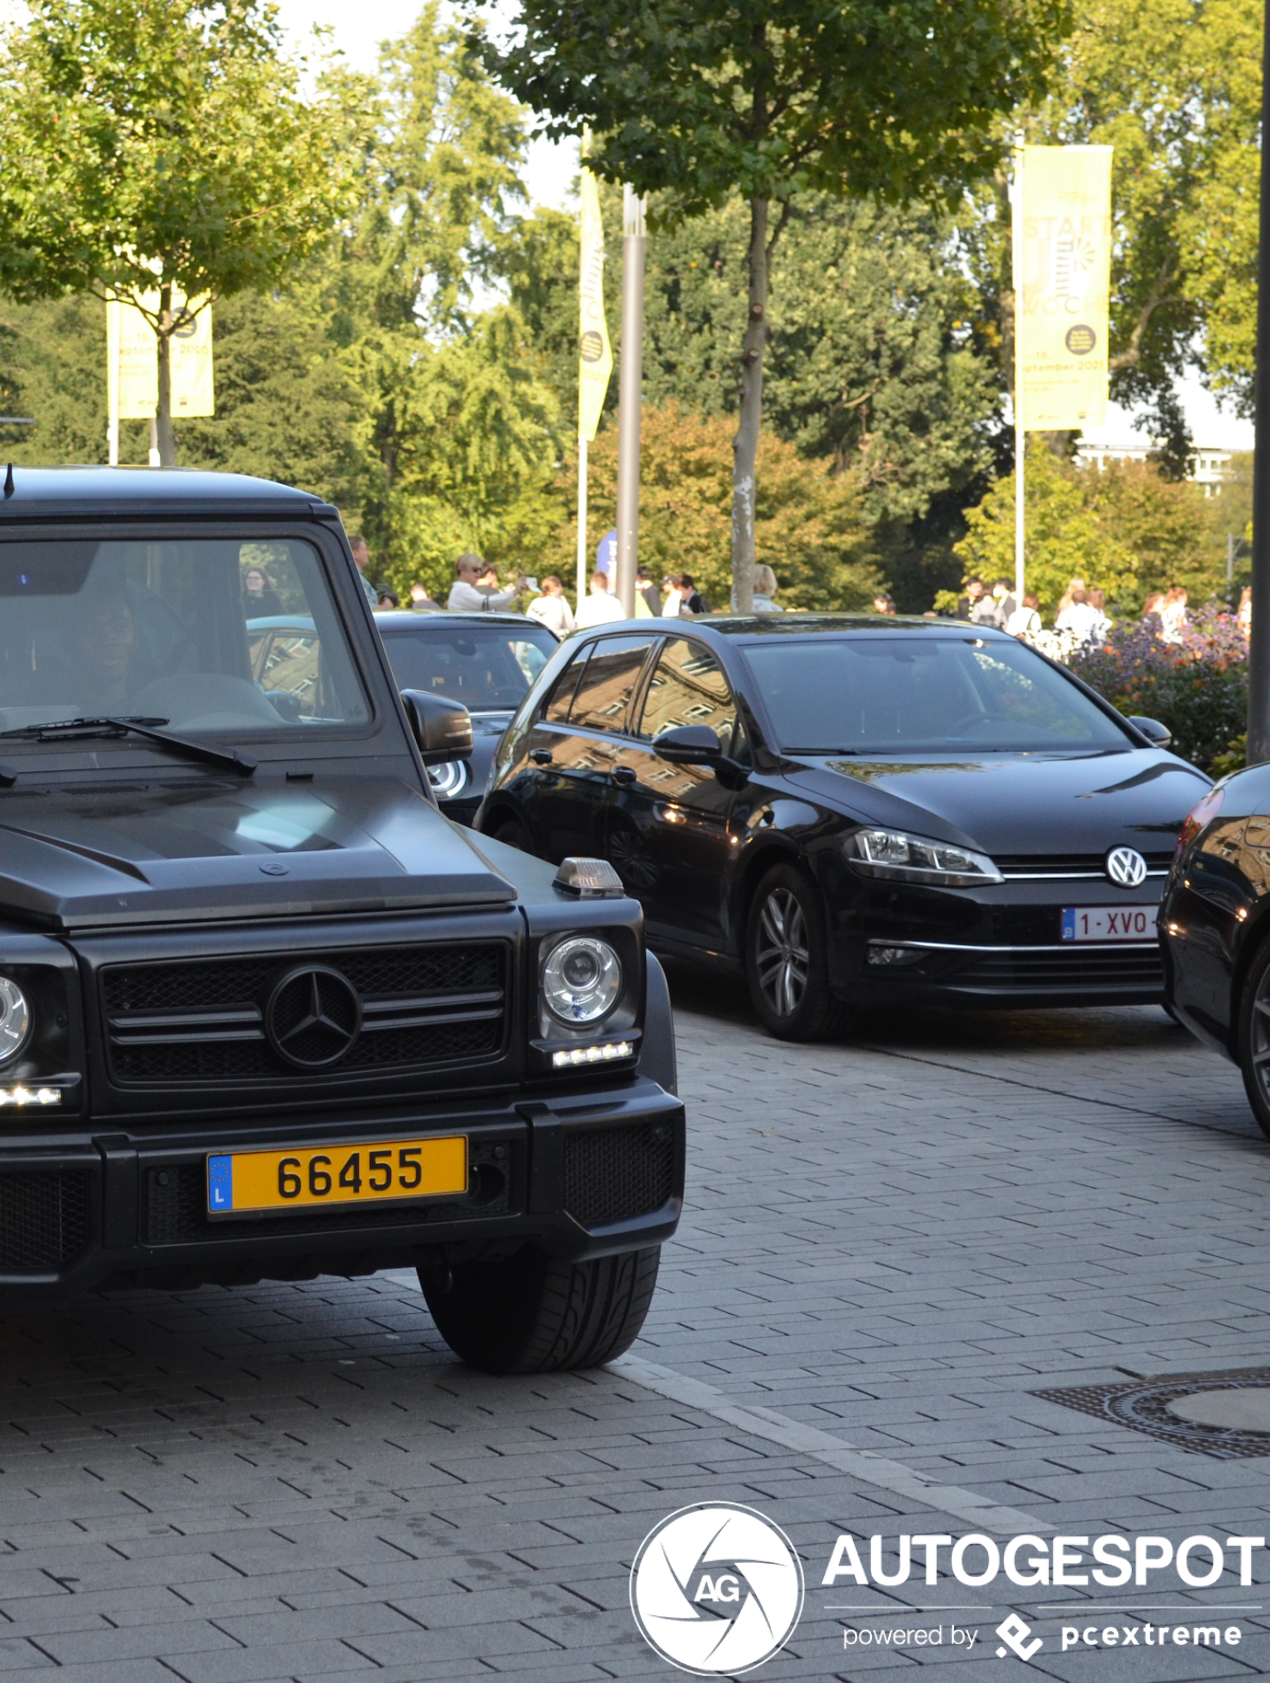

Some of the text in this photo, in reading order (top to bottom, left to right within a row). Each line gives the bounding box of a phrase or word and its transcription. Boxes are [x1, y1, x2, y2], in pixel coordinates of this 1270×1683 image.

[1065, 927, 1073, 937] B
[278, 1147, 422, 1198] 66455
[215, 1188, 224, 1203] L
